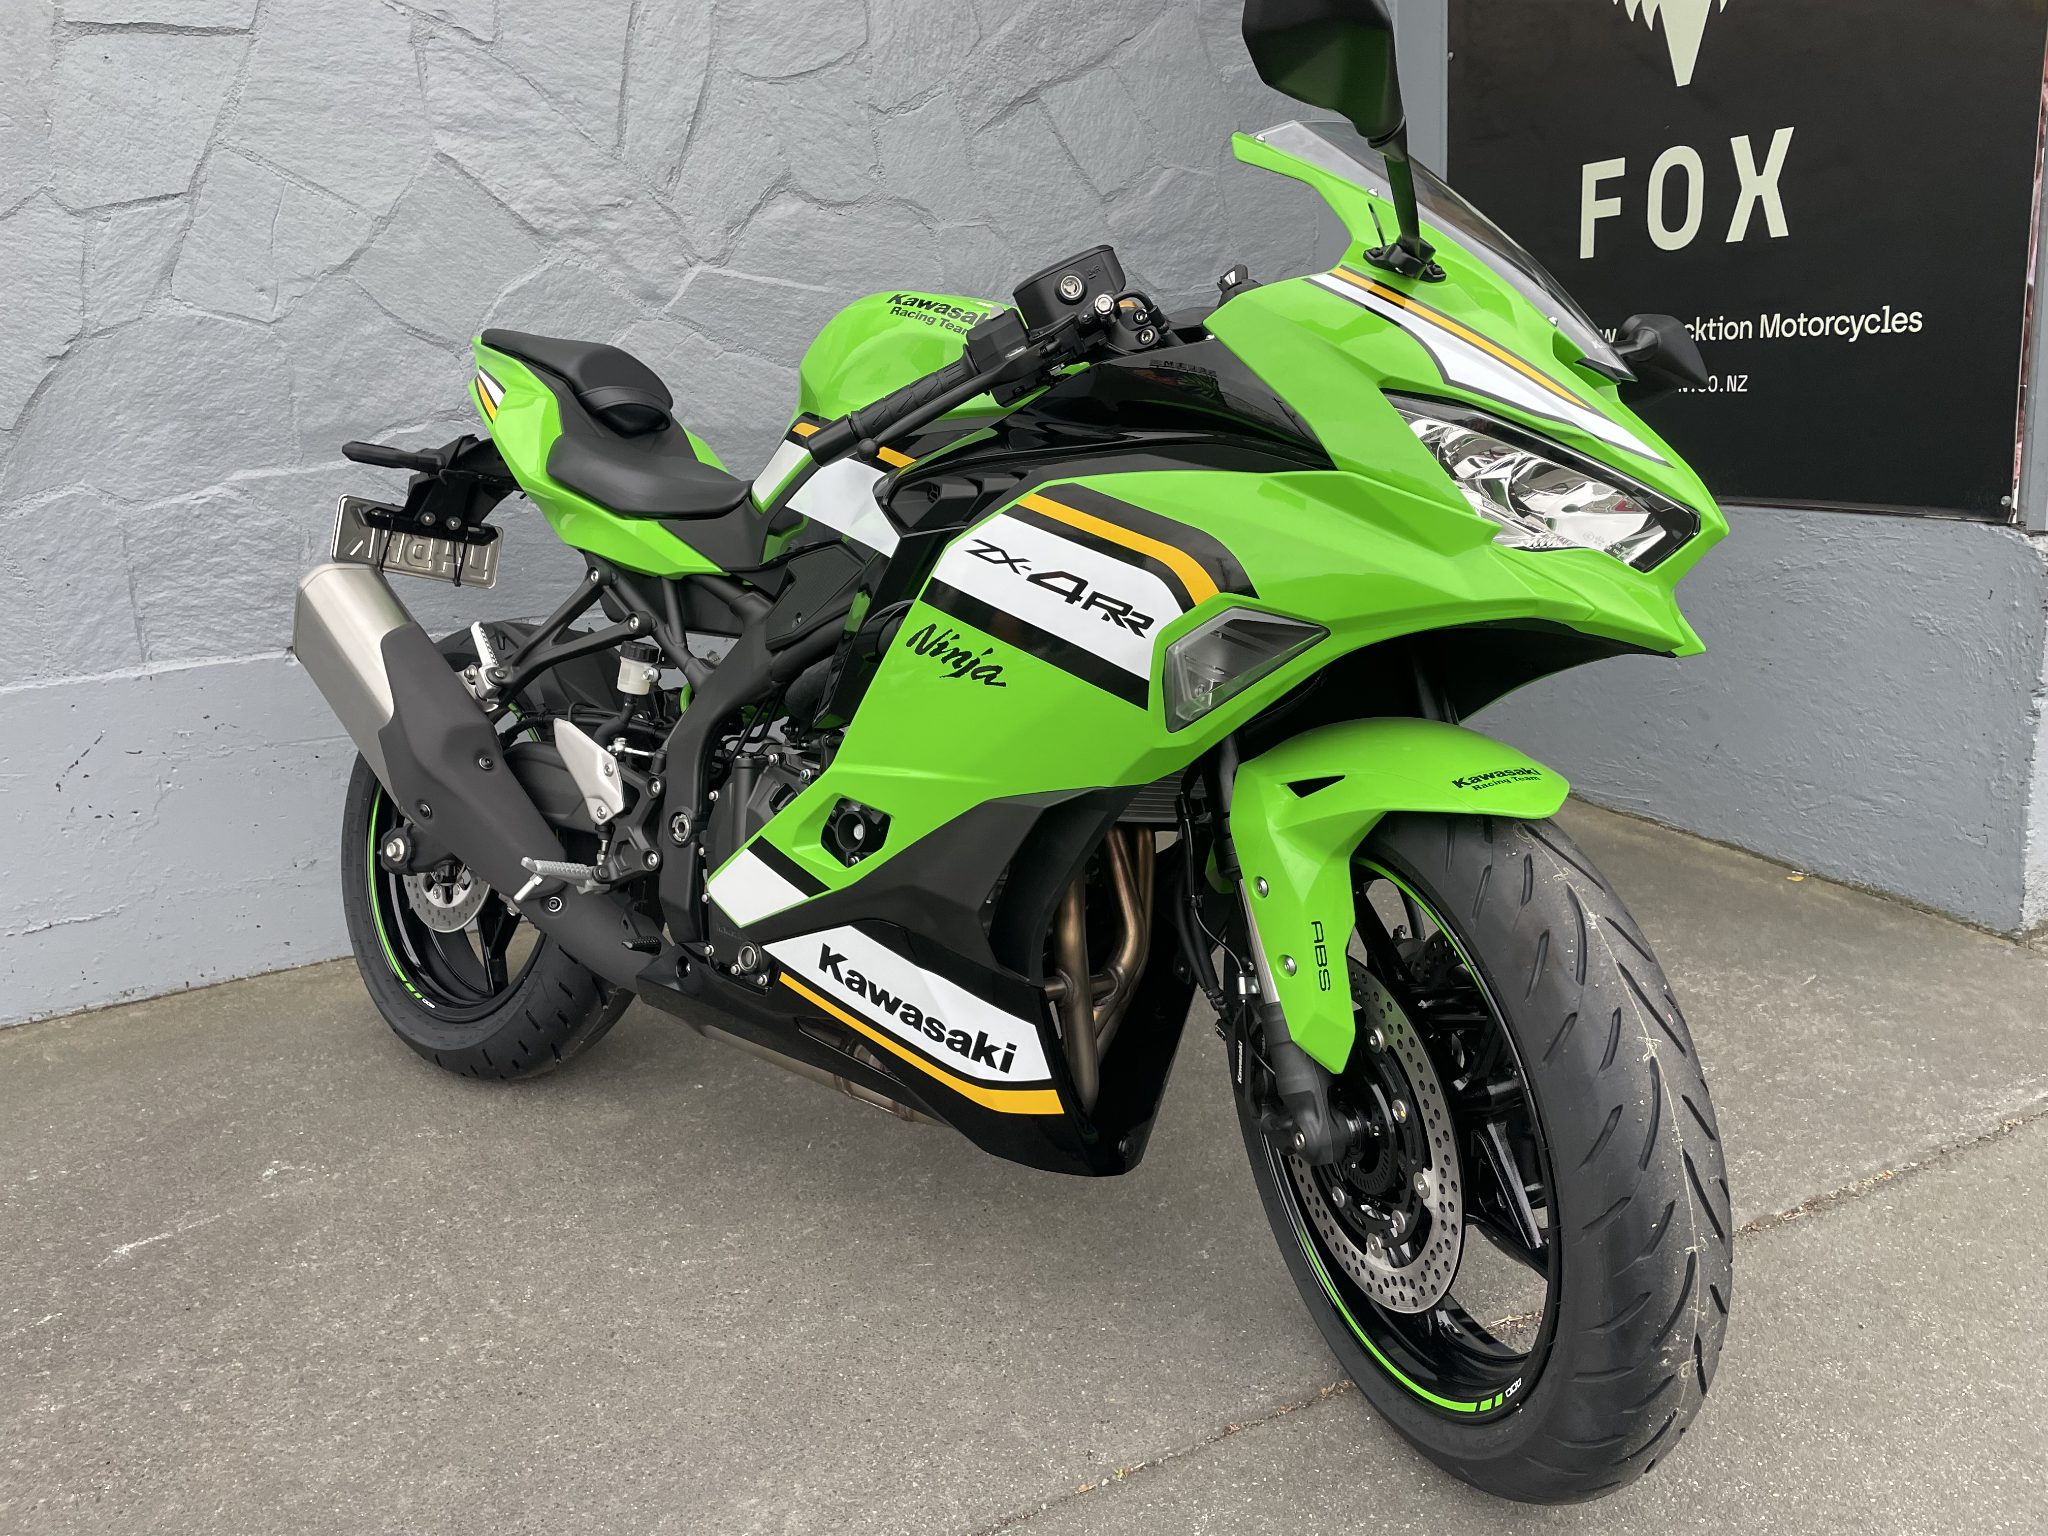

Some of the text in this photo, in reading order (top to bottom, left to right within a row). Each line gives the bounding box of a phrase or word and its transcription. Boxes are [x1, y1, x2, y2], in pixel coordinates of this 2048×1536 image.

[1580, 126, 1794, 260] FOX
[886, 293, 989, 326] Kawasa
[889, 306, 937, 326] Racing
[1759, 305, 1923, 343] Motorcycles
[905, 623, 1007, 688] Ninja
[1452, 767, 1542, 789] Kawasaki
[1472, 778, 1512, 791] Racing
[1311, 920, 1331, 991] ABS
[818, 943, 1018, 1075] Kawasaki
